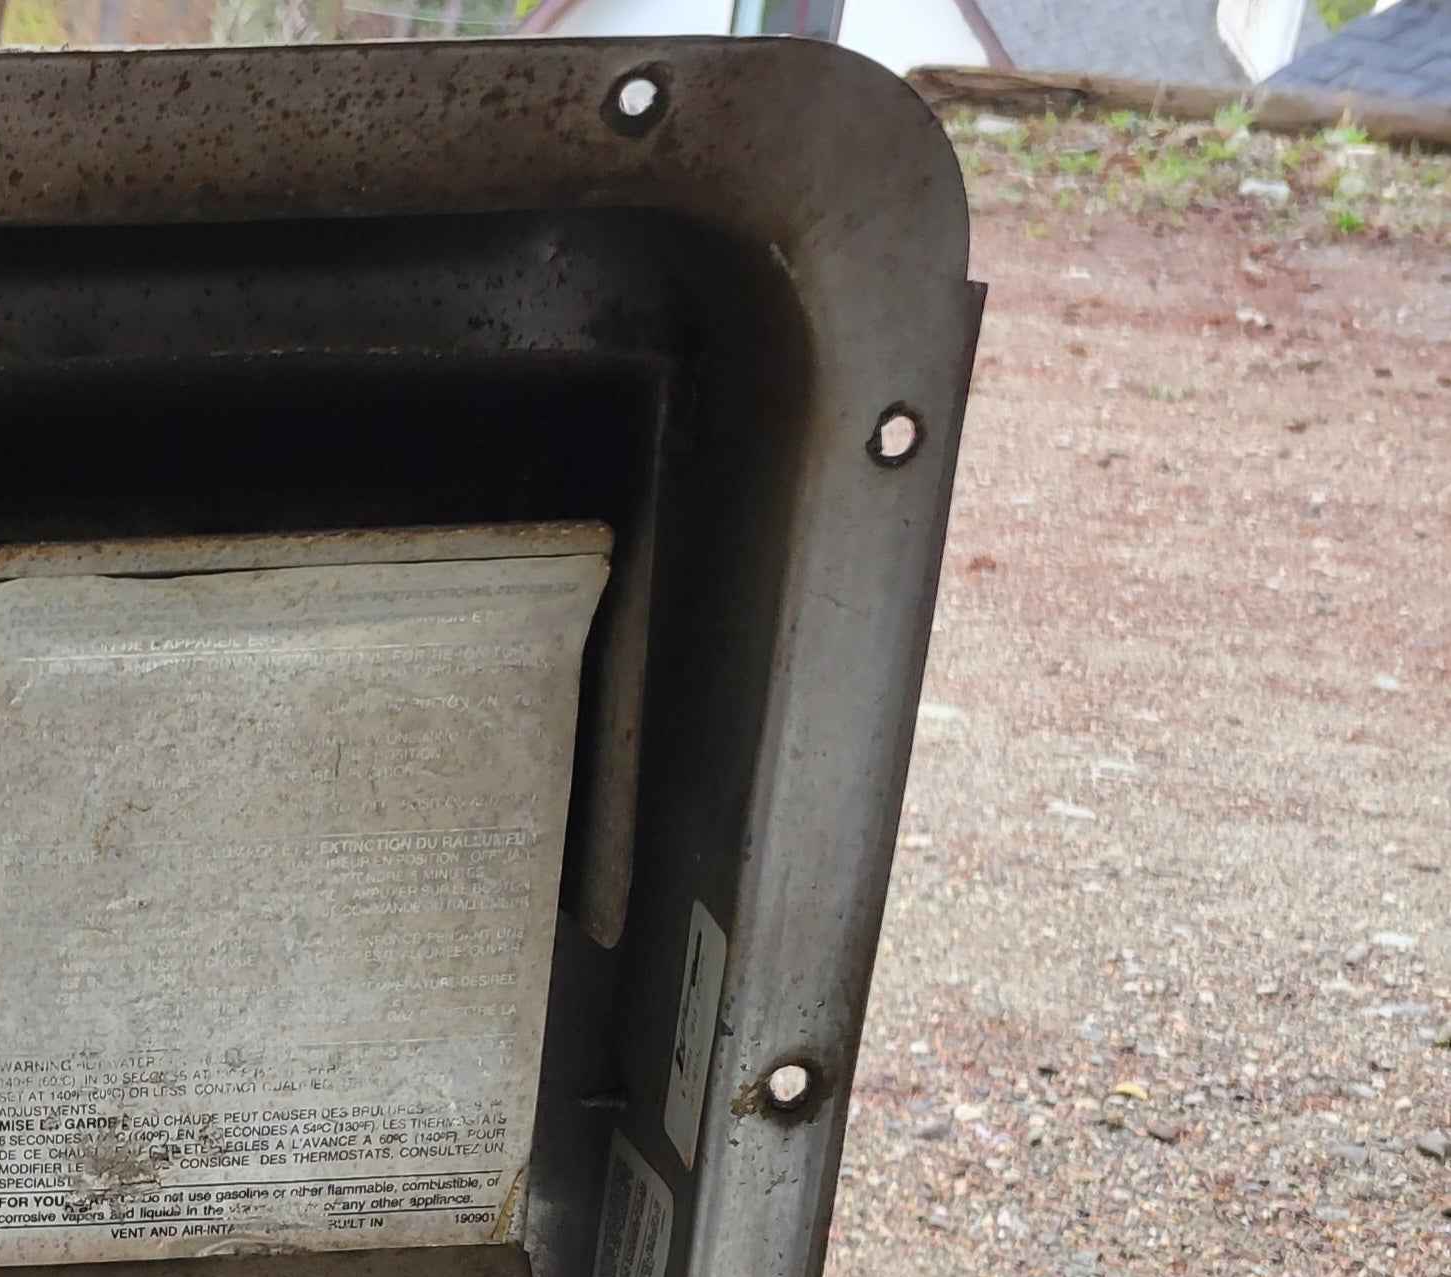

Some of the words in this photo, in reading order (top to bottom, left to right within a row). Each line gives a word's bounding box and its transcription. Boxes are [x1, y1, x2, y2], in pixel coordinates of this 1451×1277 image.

[28, 1090, 45, 1102] AT
[129, 1086, 149, 1098] OR
[164, 1112, 219, 1127] CHAUDE
[224, 1111, 259, 1124] PEUT
[262, 1108, 317, 1122] CAUSER
[9, 1132, 82, 1147] SECONDES
[382, 1118, 407, 1131] LES
[24, 1148, 42, 1161] CE
[292, 1134, 357, 1150] L'AVANCE
[468, 1127, 507, 1140] POUR
[180, 1154, 250, 1171] CONSIGNE
[260, 1153, 287, 1166] DES
[292, 1147, 394, 1165] THERMOSTATS,
[399, 1142, 480, 1159] CONSULTEZ
[484, 1141, 505, 1154] UN
[164, 1191, 184, 1203] not
[188, 1192, 212, 1203] use
[215, 1187, 269, 1203] gasoline
[327, 1180, 397, 1196] flammable,
[402, 1176, 483, 1193] combustible,
[486, 1176, 500, 1187] or
[62, 1209, 105, 1224] vapors
[186, 1204, 198, 1217] in
[203, 1204, 225, 1216] the
[342, 1200, 366, 1213] any
[370, 1196, 405, 1209] other
[111, 1226, 146, 1240] VENT
[150, 1225, 177, 1238] AND
[370, 1217, 384, 1228] IN
[454, 1212, 495, 1225] 190901
